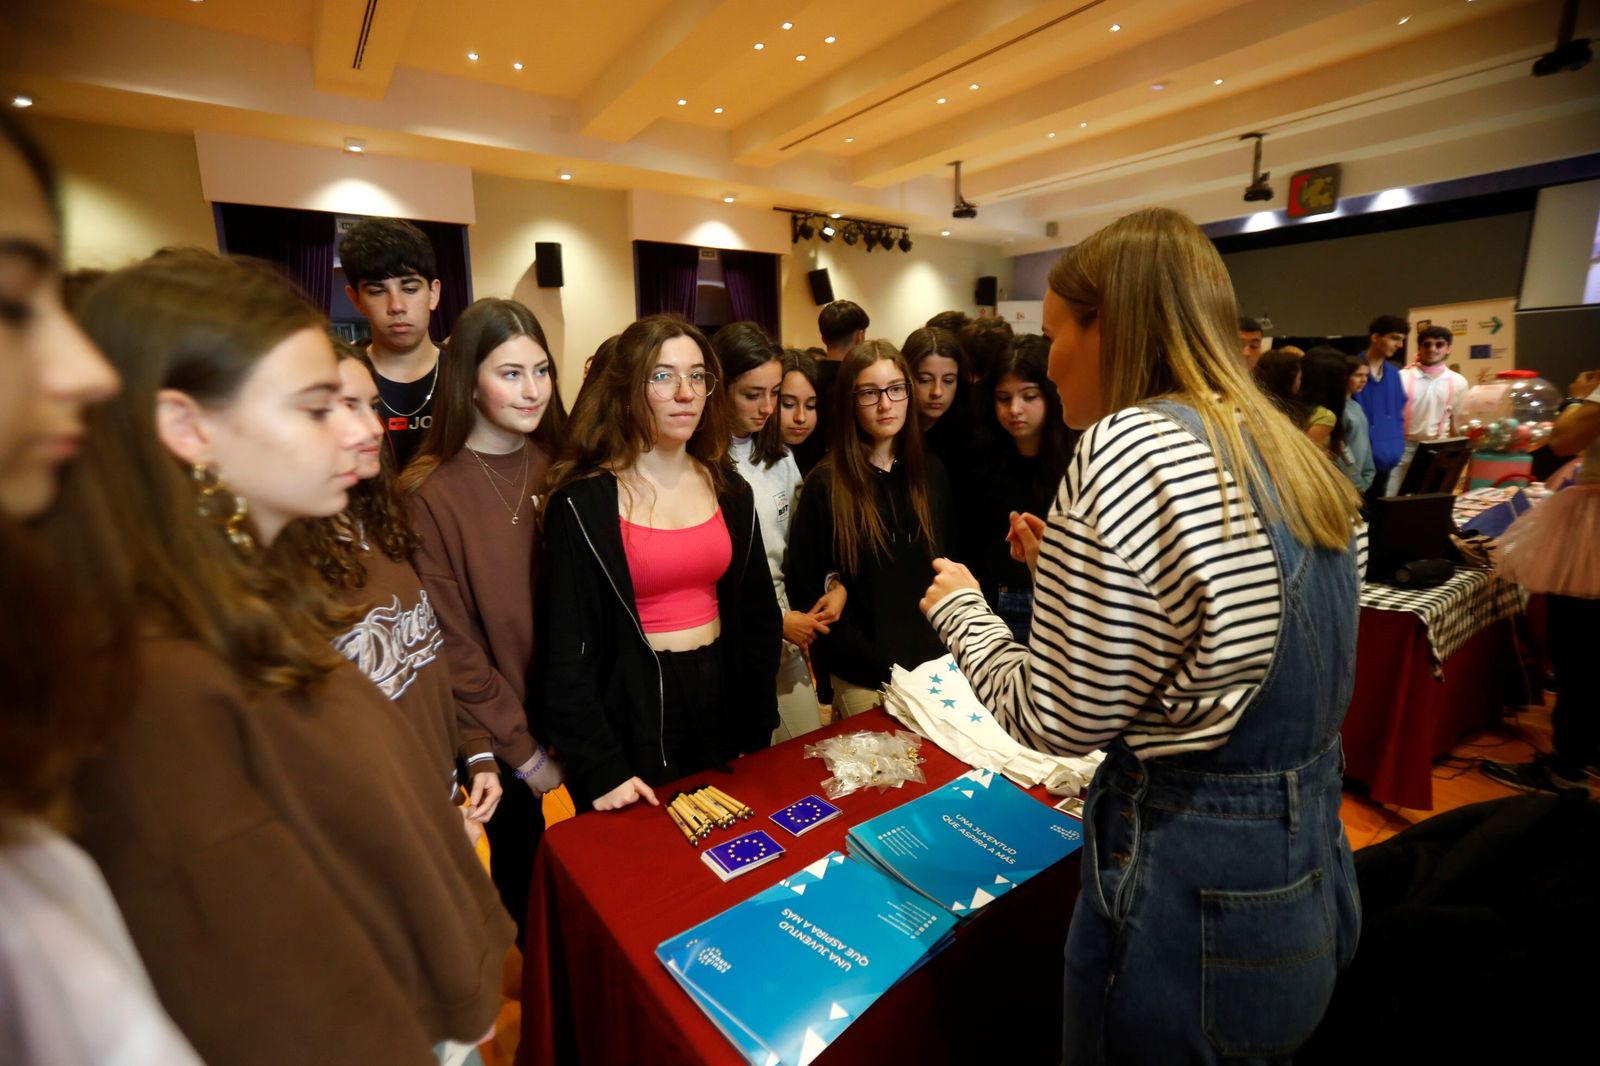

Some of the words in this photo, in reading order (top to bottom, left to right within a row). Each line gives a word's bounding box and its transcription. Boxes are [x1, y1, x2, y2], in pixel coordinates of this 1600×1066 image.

[942, 814, 961, 830] QUE
[957, 828, 988, 850] ASPIRA
[995, 850, 1016, 865] MÁS
[955, 813, 973, 829] UNA
[972, 826, 1017, 855] JUVENTUD
[781, 908, 803, 924] MÁS
[778, 920, 830, 956] JUVENTUD
[810, 926, 847, 951] ASPIRA
[828, 953, 852, 972] UNA
[845, 946, 869, 967] QUE
